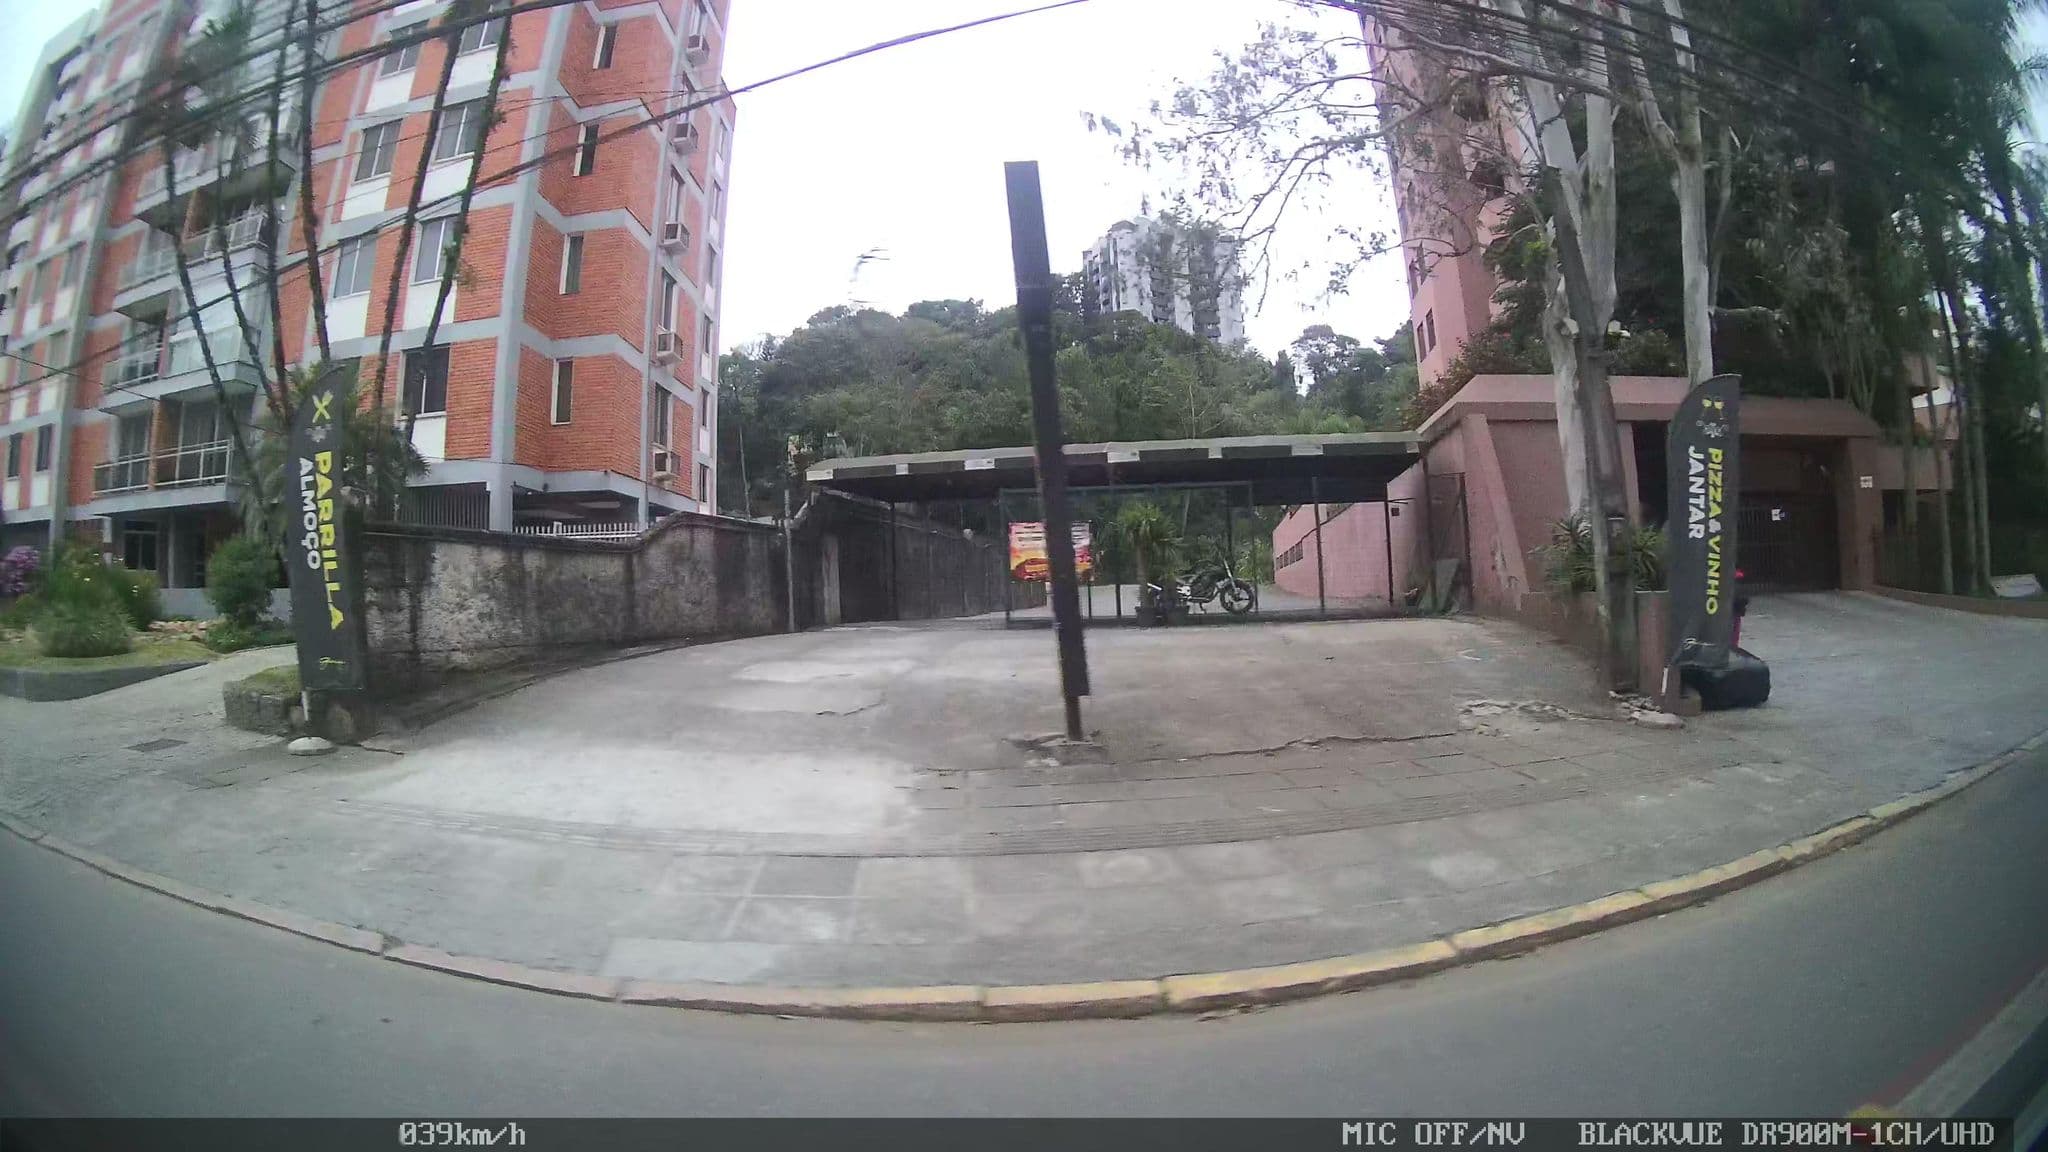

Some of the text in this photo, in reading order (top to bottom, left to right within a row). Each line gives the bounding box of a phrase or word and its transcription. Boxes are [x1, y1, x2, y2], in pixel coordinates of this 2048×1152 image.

[299, 457, 321, 570] ALMOÇO
[1687, 445, 1706, 540] JANTAR
[1707, 447, 1723, 518] PIZZA
[314, 450, 345, 631] PARRILLA
[1706, 535, 1721, 615] VINHO
